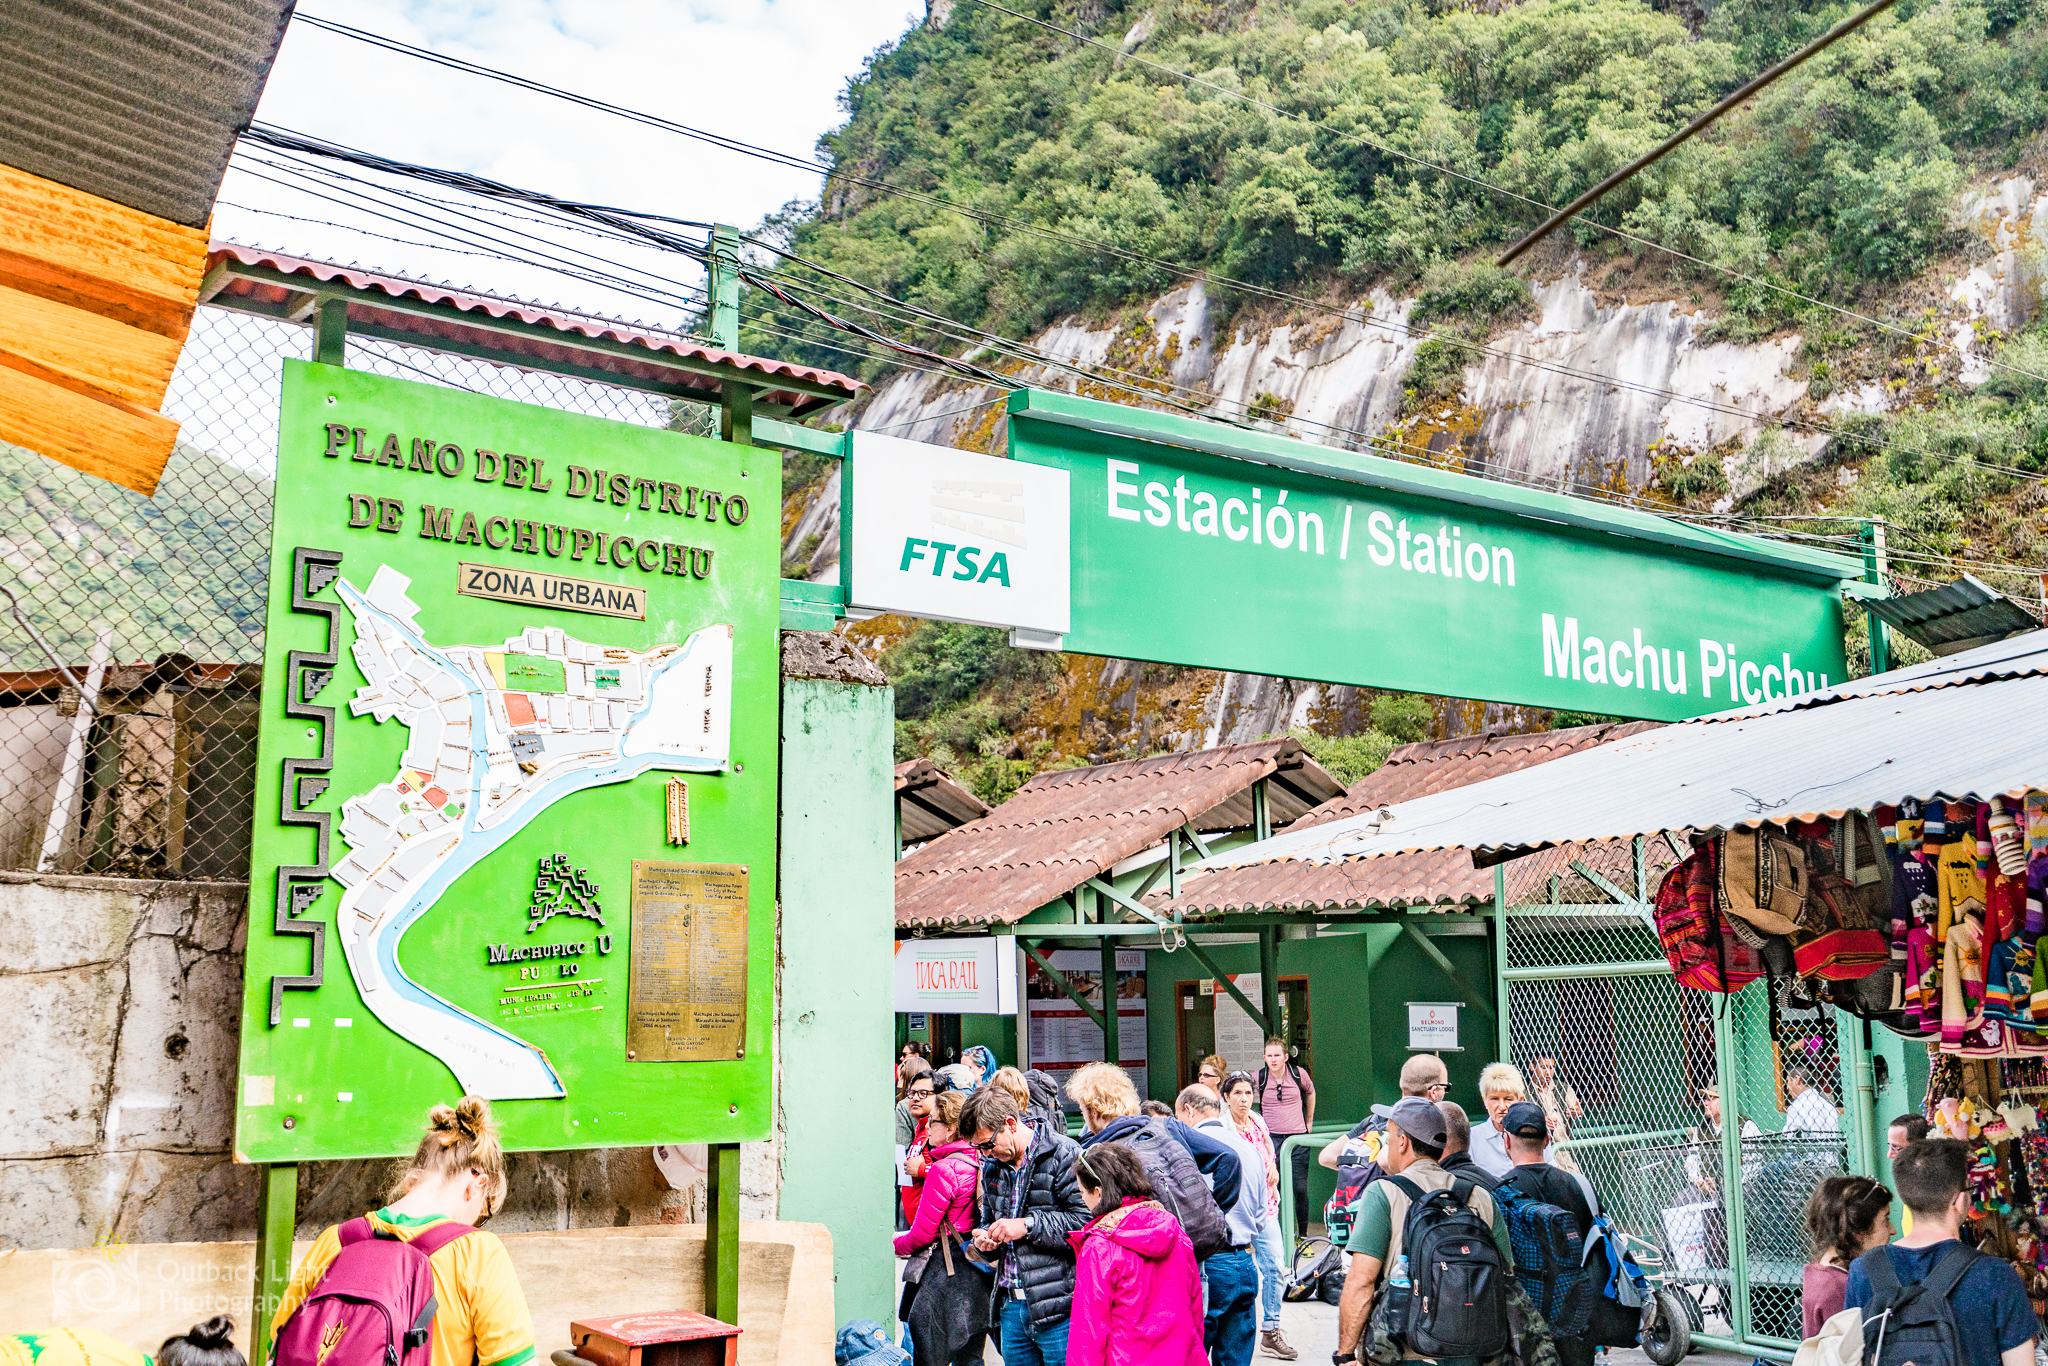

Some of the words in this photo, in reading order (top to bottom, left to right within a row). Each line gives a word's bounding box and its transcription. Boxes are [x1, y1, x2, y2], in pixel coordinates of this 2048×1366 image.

[324, 422, 465, 478] PLANO
[475, 449, 553, 493] DEL
[567, 464, 750, 527] DISTRITO
[348, 492, 405, 534] DE
[420, 503, 715, 580] MACHUPICCHU
[1107, 458, 1325, 555] Estación
[1340, 505, 1352, 559] /
[1367, 511, 1515, 587] Station
[467, 568, 537, 599] ZONA
[543, 579, 638, 613] URBANA
[899, 537, 1012, 588] FTSA
[1541, 613, 1688, 696] Machu
[915, 960, 947, 990] INCA
[949, 960, 979, 990] RAIL
[483, 1050, 516, 1069] RUNAS
